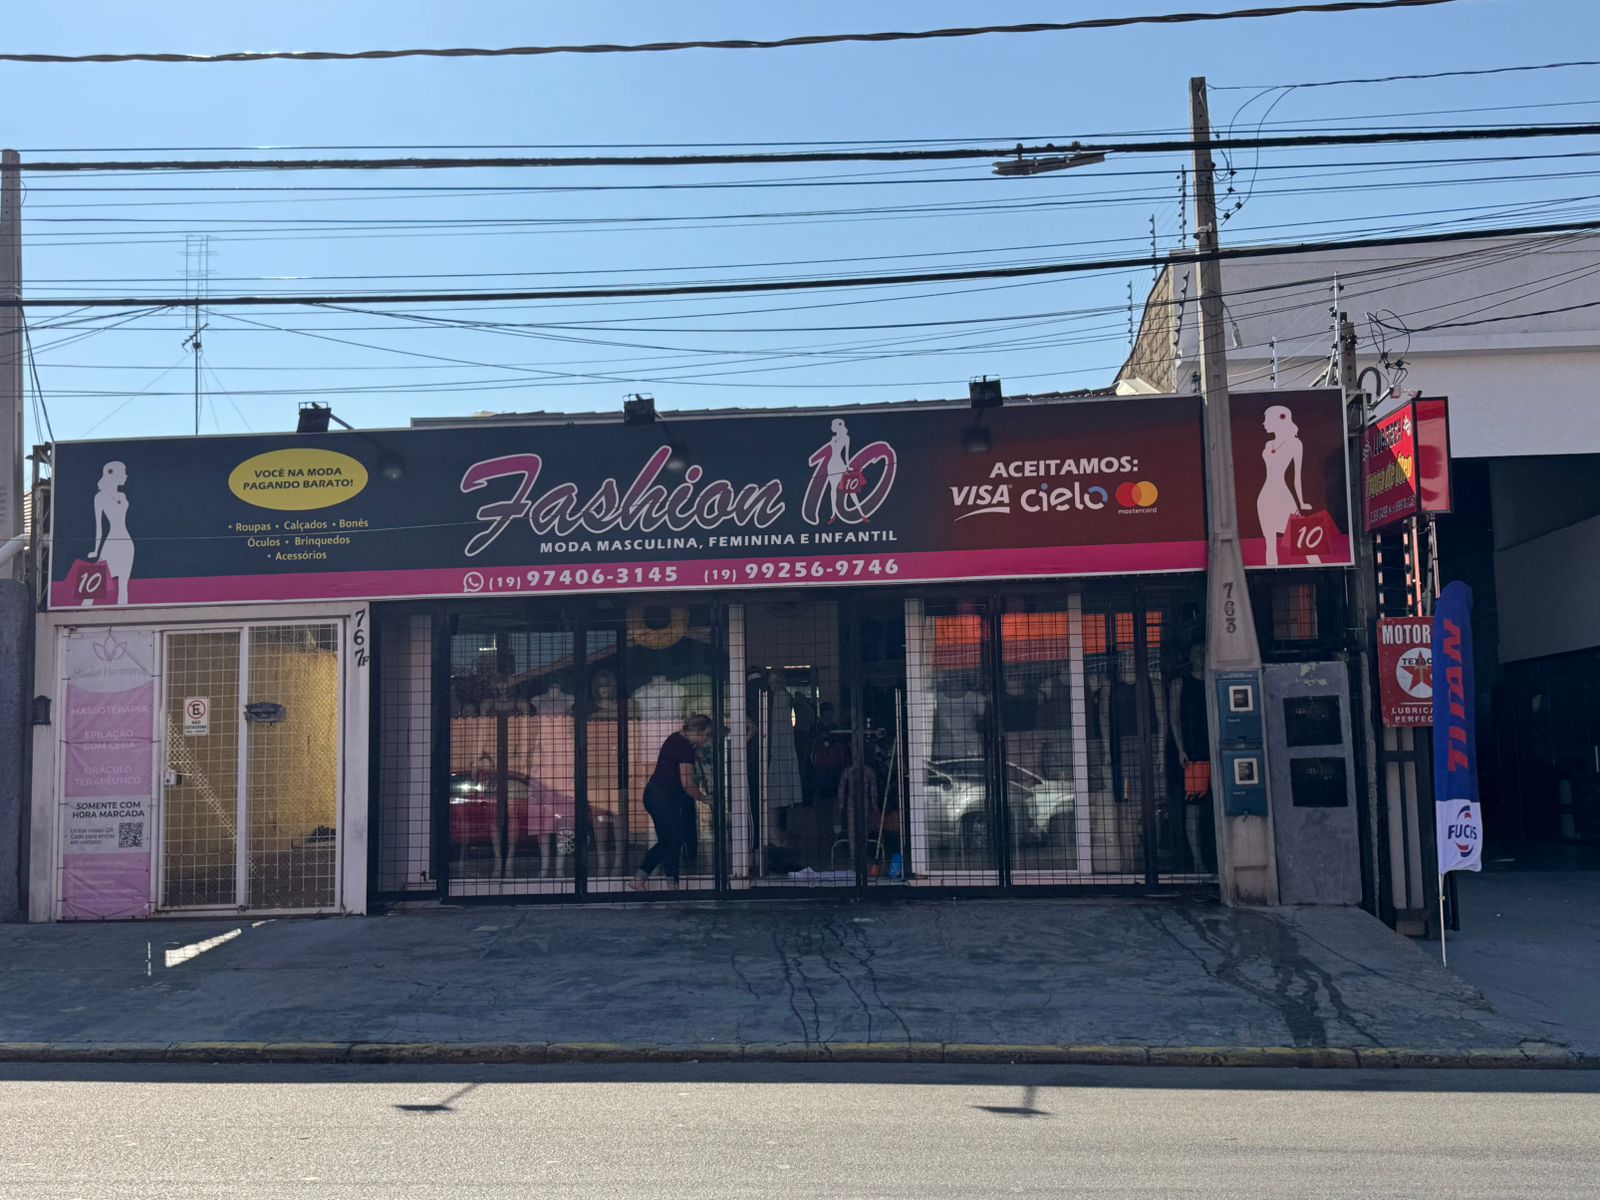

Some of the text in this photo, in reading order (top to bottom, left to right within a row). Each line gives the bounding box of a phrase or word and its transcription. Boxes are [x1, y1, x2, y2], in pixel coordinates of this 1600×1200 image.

[254, 467, 342, 479] VOCÊ NA MODA
[989, 455, 1139, 479] ACEITAMOS:
[243, 478, 353, 490] PAGANDO BARATO!
[845, 478, 859, 490] 10
[460, 440, 897, 557] Fashion 10
[949, 484, 1010, 506] VISA
[1020, 481, 1109, 513] cielo
[1118, 506, 1158, 515] mastercard
[235, 518, 369, 533] Roupas Calçados Bonés
[247, 535, 351, 548] Óculos Brinquedos
[540, 530, 898, 553] MODA MASCULINA, FEMININA E INFANTIL
[1296, 525, 1324, 549] 10
[275, 550, 327, 561] Acessórios
[489, 558, 899, 590] (19) 97406-3145 (19) 99256-9746
[78, 572, 102, 593] 10
[1382, 624, 1432, 645] MOTOR
[1402, 657, 1433, 666] TEXAC
[1395, 715, 1433, 723] PERFEC
[76, 801, 141, 810] SOMENTE COM
[72, 809, 145, 819] HORA MARCADA
